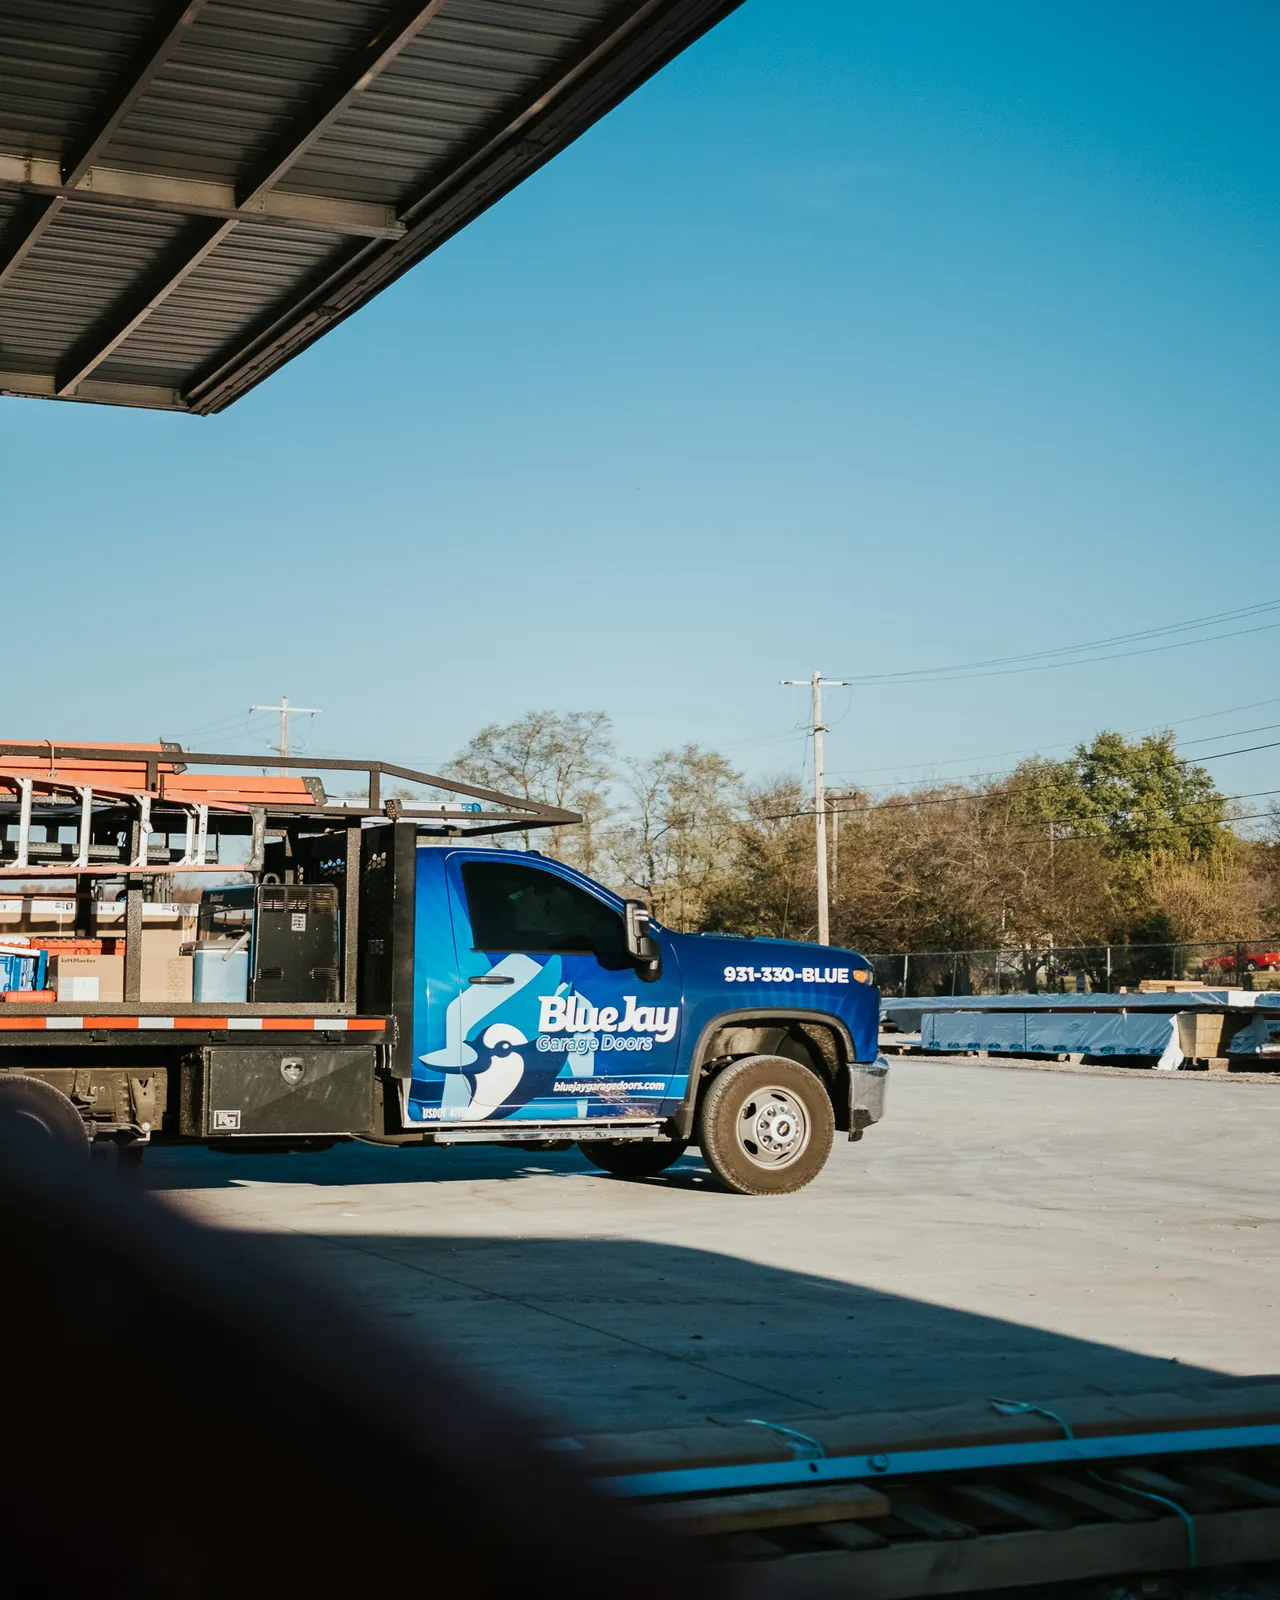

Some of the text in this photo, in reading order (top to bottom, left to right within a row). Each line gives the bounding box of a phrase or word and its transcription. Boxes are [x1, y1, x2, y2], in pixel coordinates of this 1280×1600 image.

[724, 967, 849, 983] 931-330-BLUE
[536, 1034, 653, 1054] Garage Doors
[553, 1081, 665, 1093] bluejaygaragedoors.com
[422, 1107, 446, 1119] USDOT
